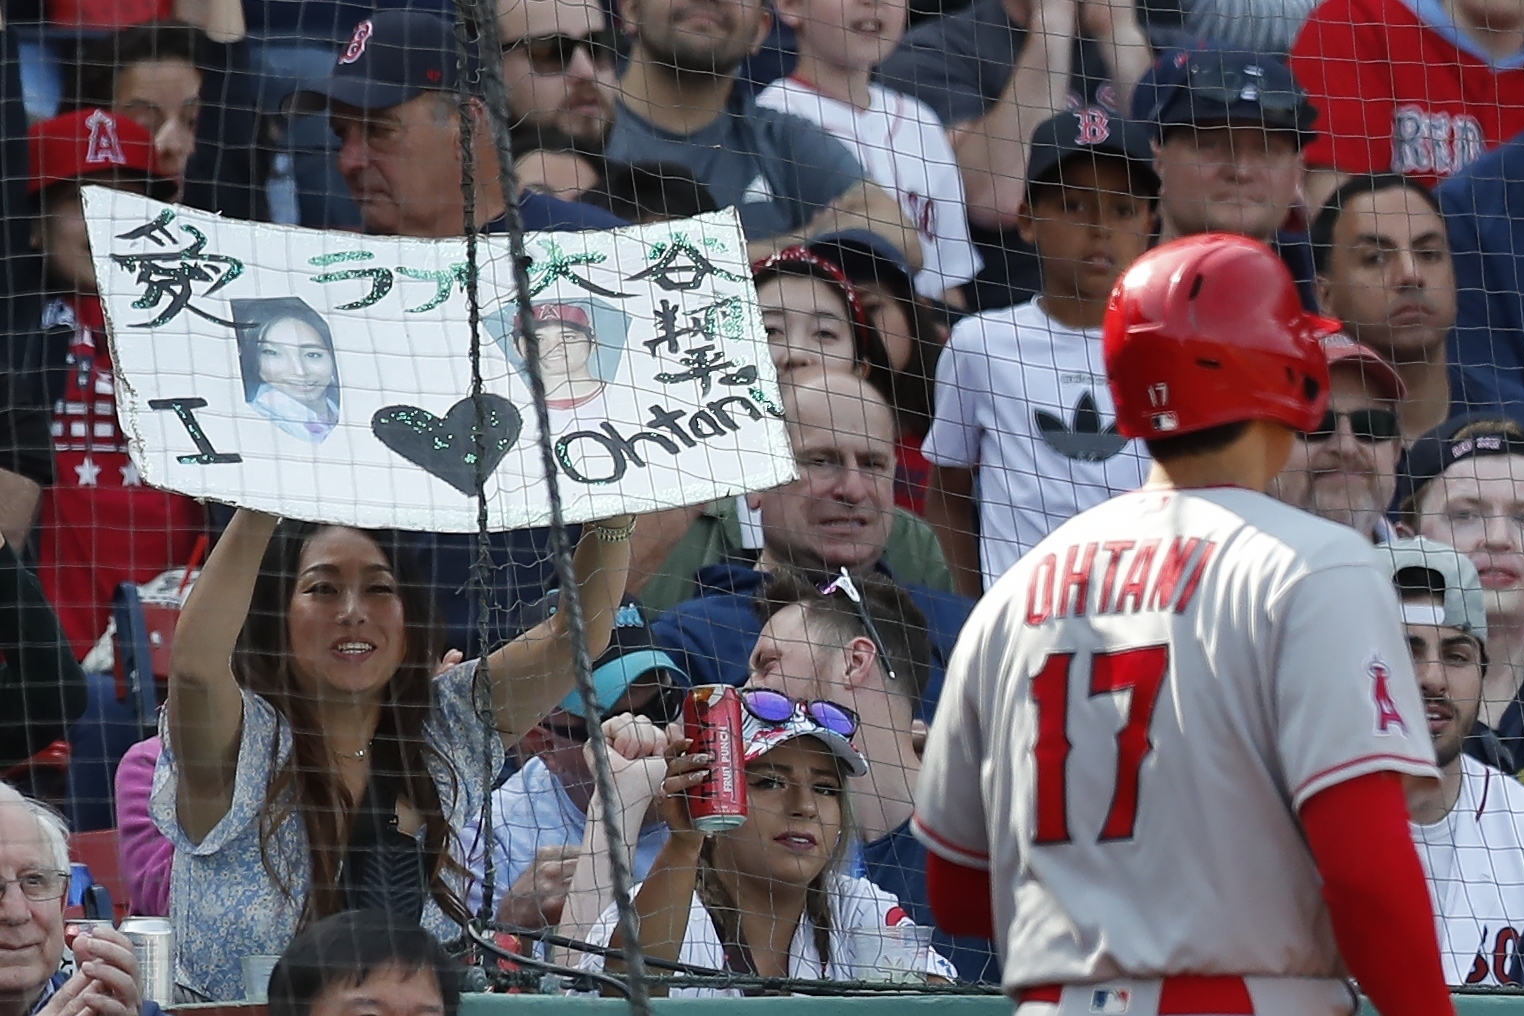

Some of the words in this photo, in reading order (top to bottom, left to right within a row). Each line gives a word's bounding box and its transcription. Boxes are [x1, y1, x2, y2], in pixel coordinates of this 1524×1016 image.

[1073, 107, 1111, 146] B
[109, 208, 260, 328] 愛
[148, 397, 243, 465] I
[1147, 382, 1170, 407] 17
[1025, 535, 1218, 627] OHTANI
[1030, 643, 1170, 845] 17
